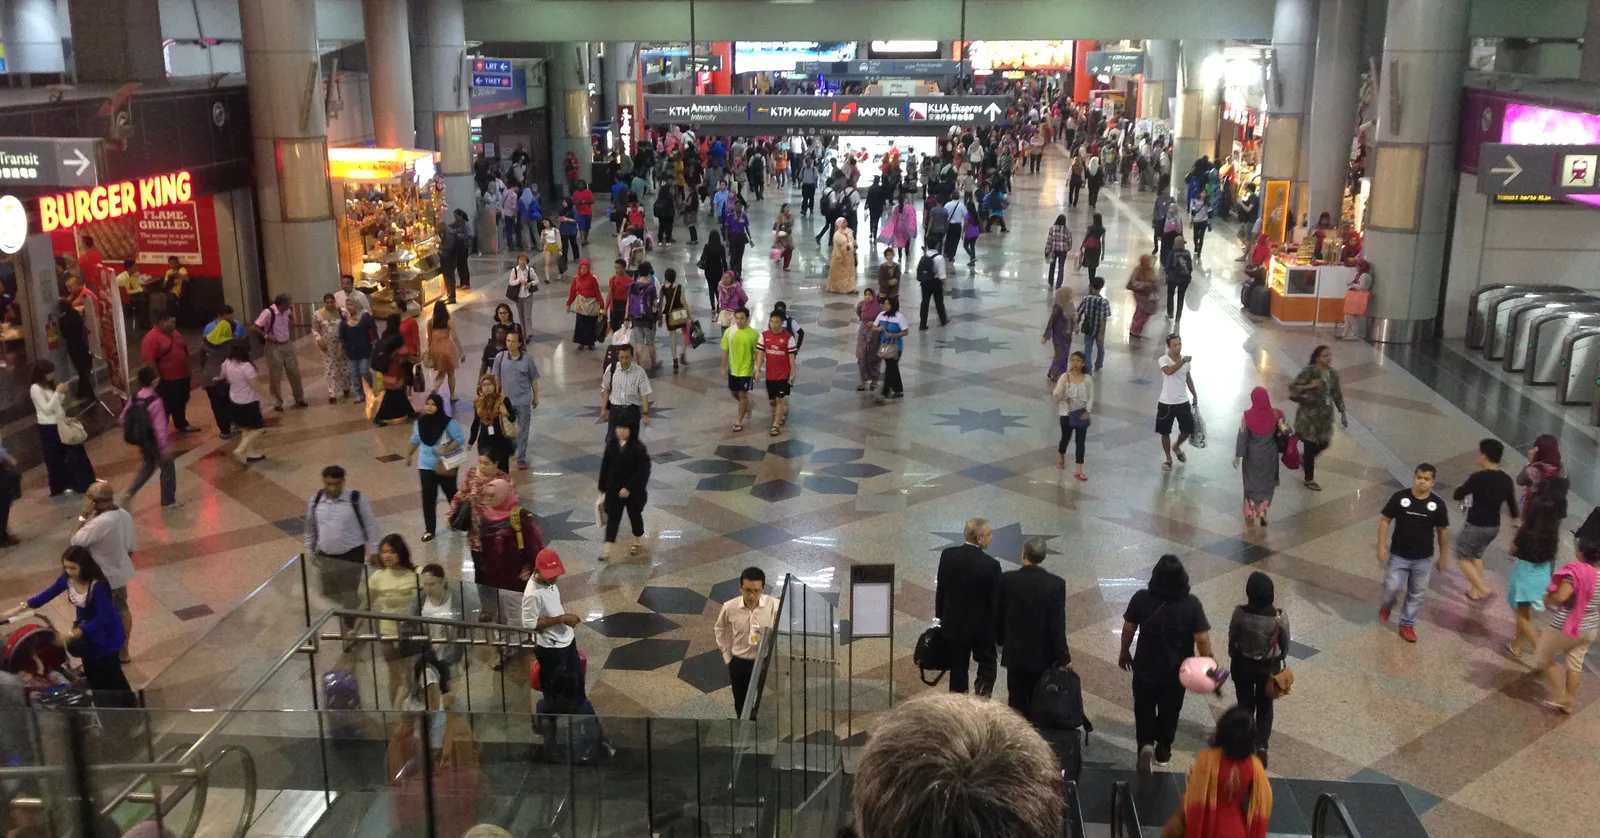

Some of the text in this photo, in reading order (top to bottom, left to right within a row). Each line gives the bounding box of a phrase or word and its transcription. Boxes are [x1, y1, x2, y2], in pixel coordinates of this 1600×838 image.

[669, 103, 746, 116] KTM Antarabandar
[770, 106, 832, 116] KTM Komuter
[857, 107, 900, 117] RAPID KL
[928, 103, 983, 115] KLIA Ekspres
[690, 114, 717, 122] Intercity
[0, 151, 40, 165] Transit
[39, 171, 192, 232] BURGER KING
[143, 210, 187, 220] FLAME-
